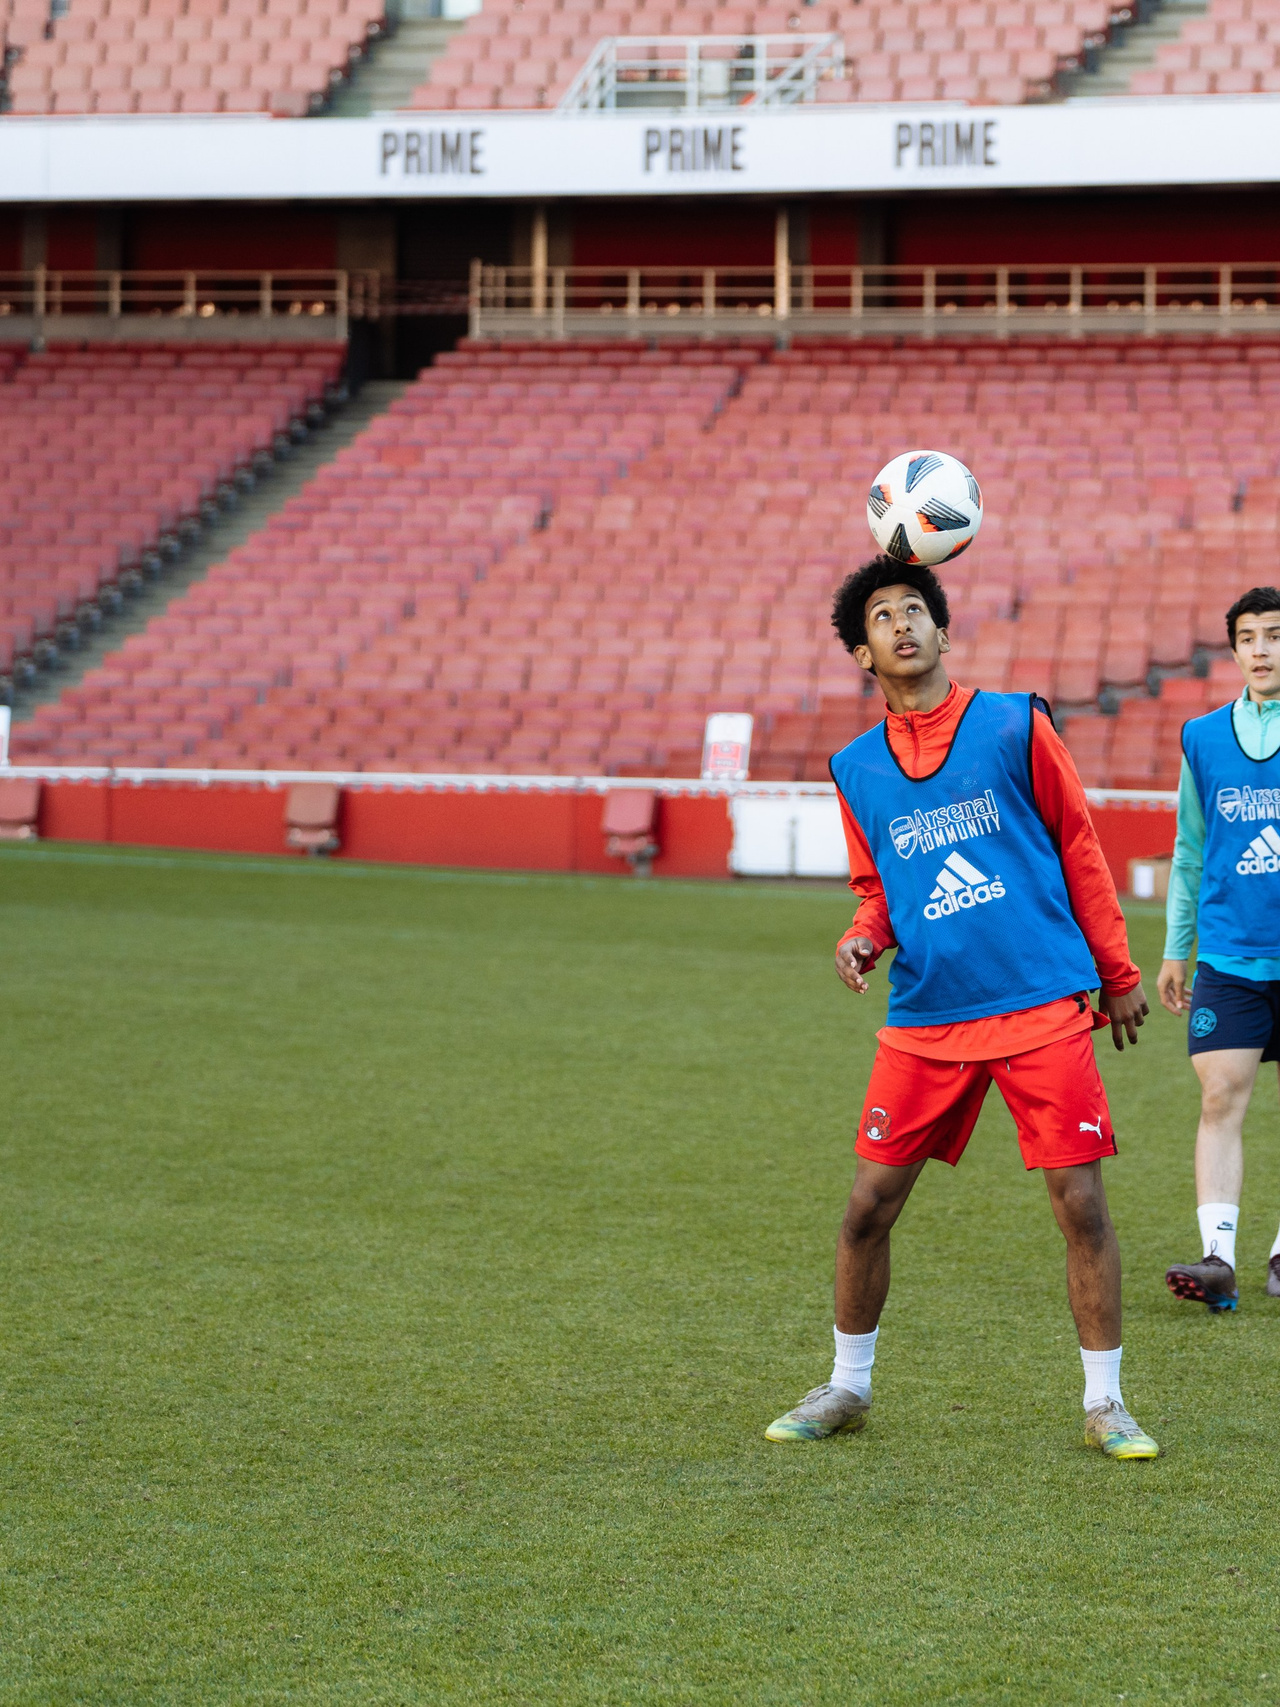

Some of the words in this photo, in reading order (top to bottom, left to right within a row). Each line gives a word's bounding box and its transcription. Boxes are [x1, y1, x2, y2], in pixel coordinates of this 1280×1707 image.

[381, 131, 485, 174] PRIME
[643, 127, 745, 172] PRIME
[895, 120, 997, 167] PRIME
[914, 789, 998, 836] Arsenal
[918, 813, 1001, 854] COMMUNITY
[923, 881, 1006, 920] adidas
